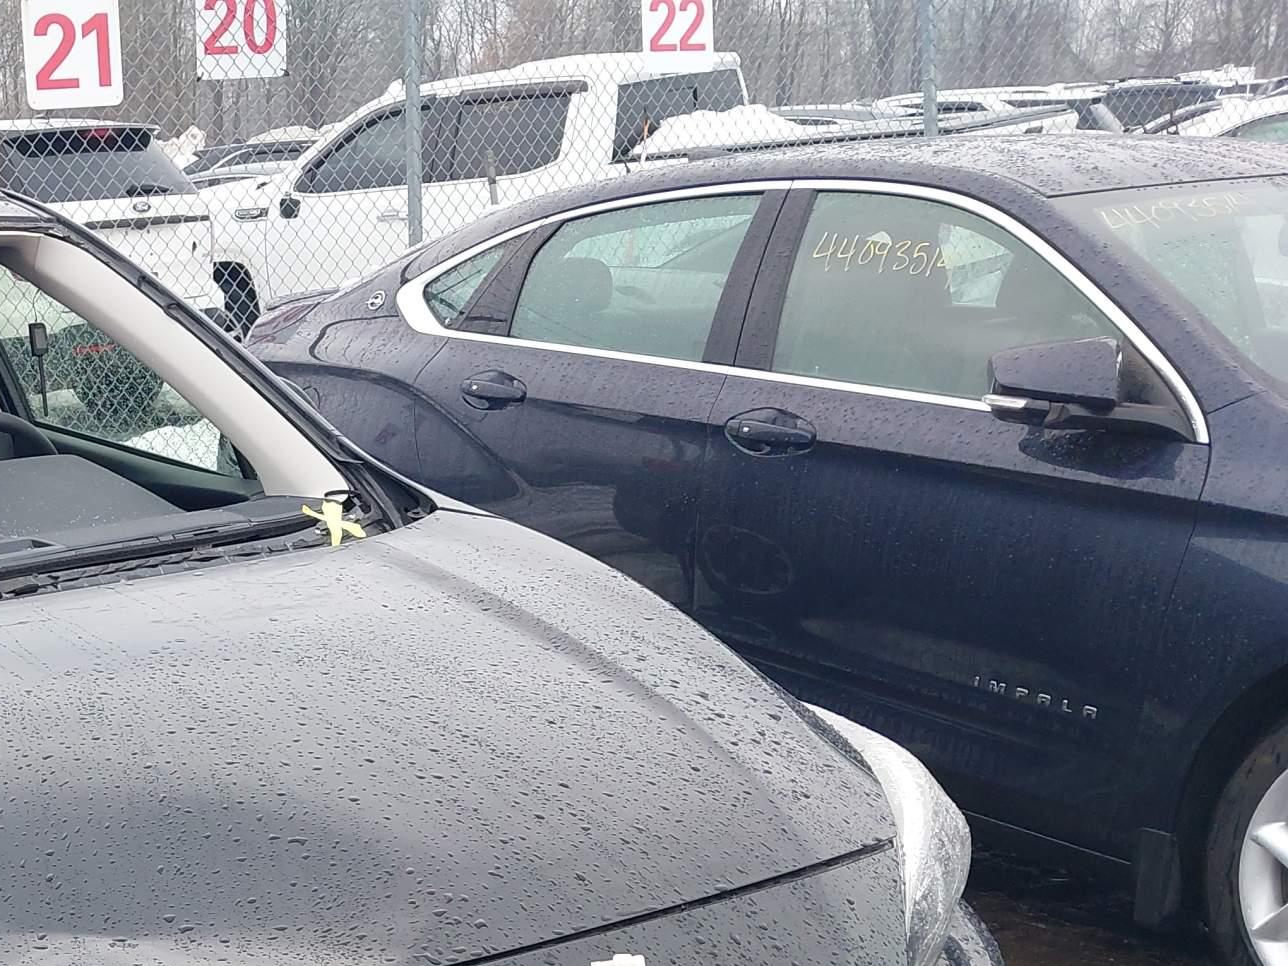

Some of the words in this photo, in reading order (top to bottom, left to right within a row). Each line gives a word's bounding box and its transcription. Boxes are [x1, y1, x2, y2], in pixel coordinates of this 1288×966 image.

[33, 12, 112, 91] 21
[203, 0, 277, 56] 20
[649, 0, 707, 52] 22
[971, 675, 1099, 720] IMPALA
